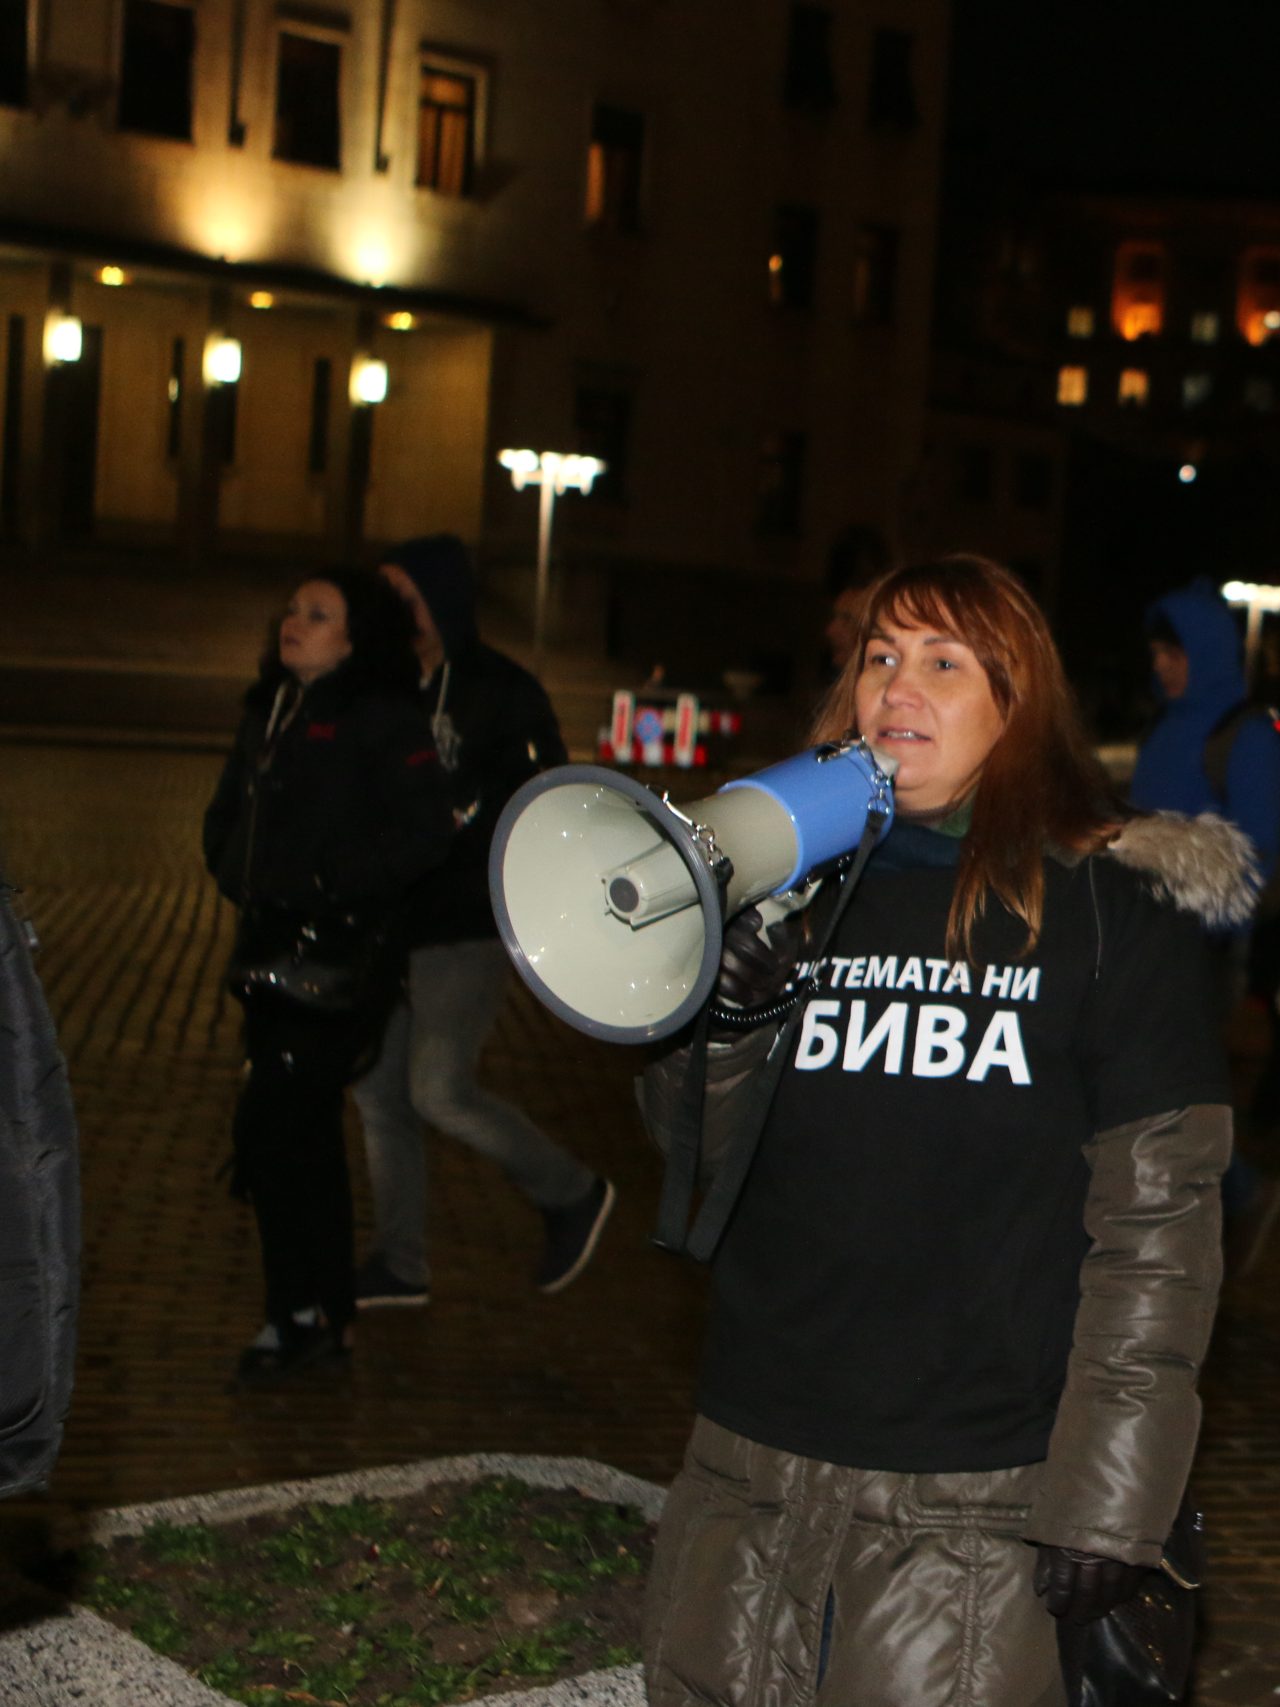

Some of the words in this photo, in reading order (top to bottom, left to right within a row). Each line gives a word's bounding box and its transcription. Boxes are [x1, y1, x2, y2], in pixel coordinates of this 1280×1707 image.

[785, 955, 972, 993] ТЕМАТА
[981, 965, 1041, 1000] НИ
[795, 998, 1035, 1085] БИВА
